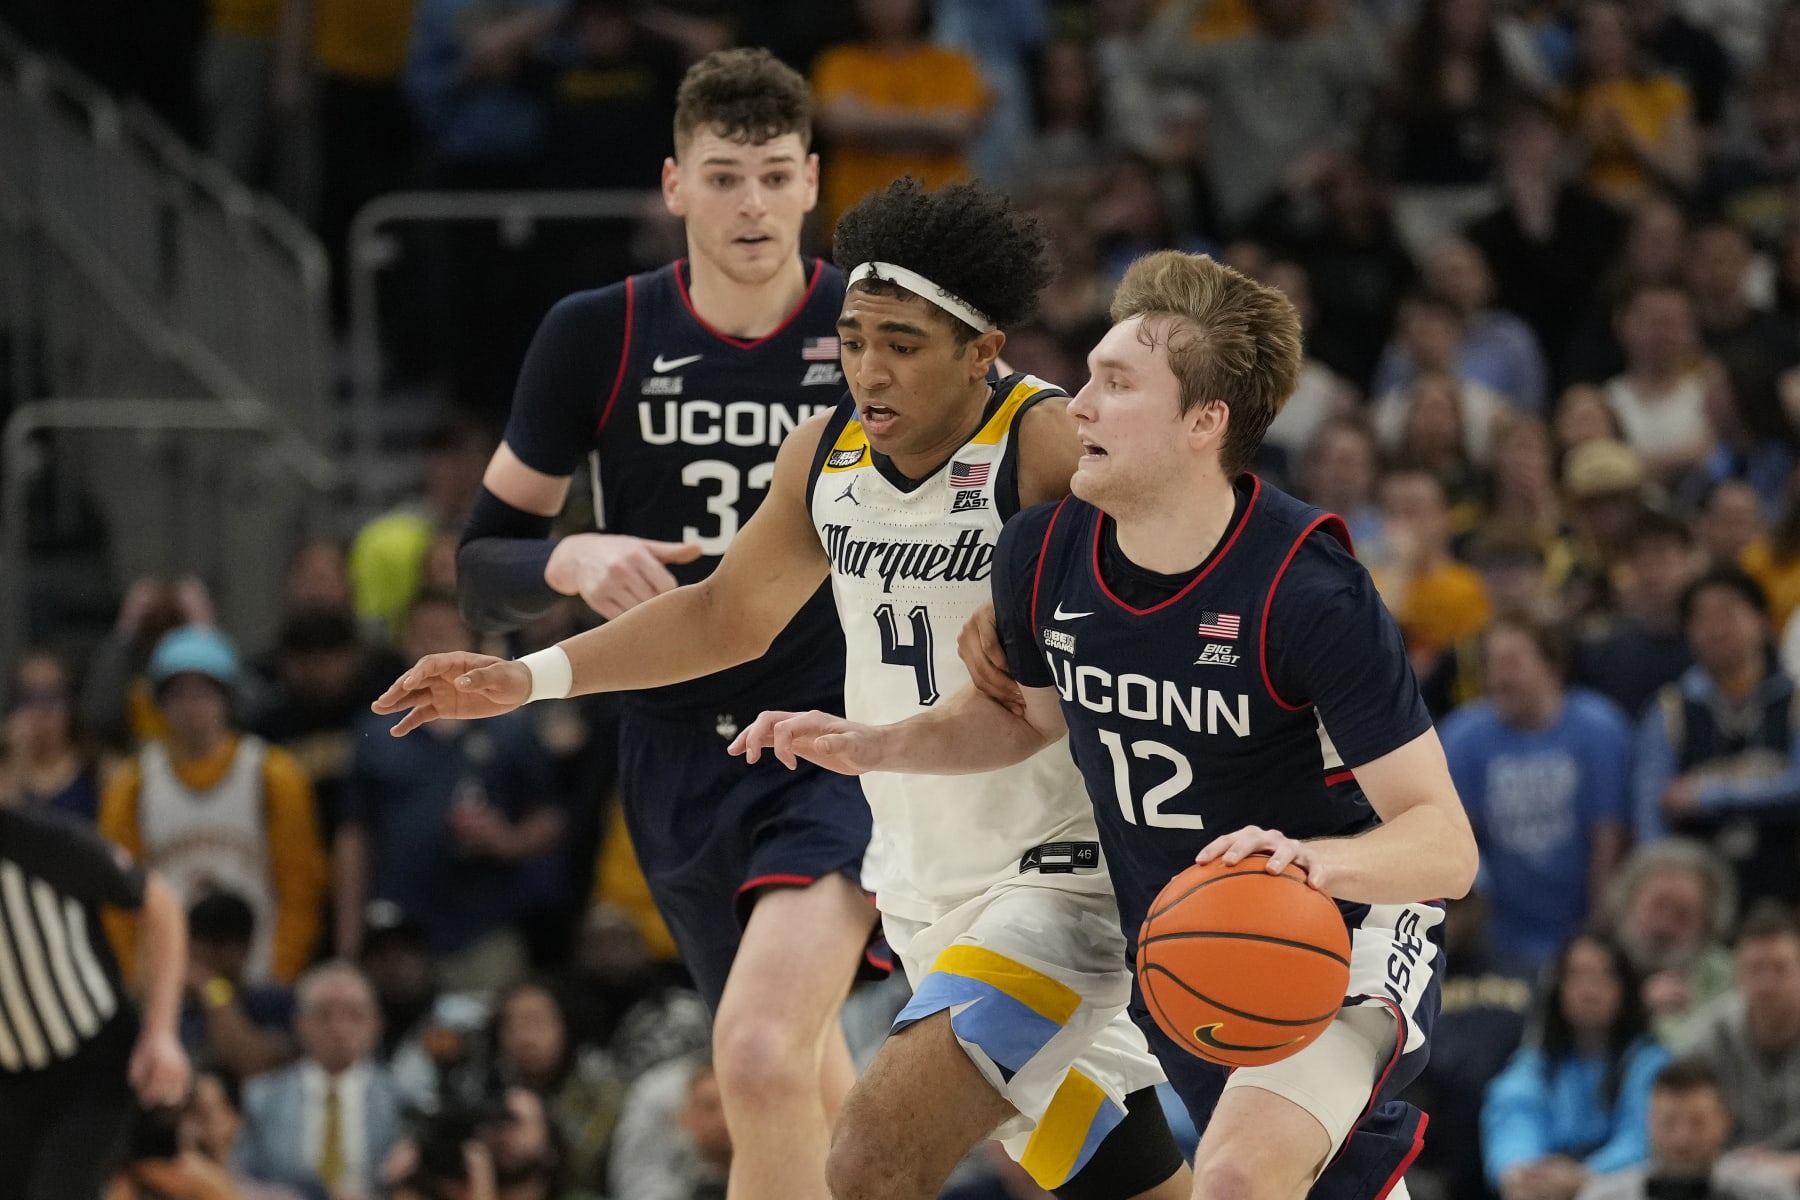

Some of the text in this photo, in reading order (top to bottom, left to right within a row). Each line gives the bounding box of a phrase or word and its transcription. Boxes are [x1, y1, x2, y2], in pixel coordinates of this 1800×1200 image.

[638, 400, 828, 447] UCON
[681, 459, 775, 556] 3
[953, 498, 989, 509] EAST
[955, 489, 982, 500] BIG
[822, 523, 994, 594] Marquette
[873, 603, 940, 706] 4
[1198, 652, 1241, 664] EAST
[1203, 643, 1233, 655] BIG
[1045, 650, 1251, 738] UCONN
[1098, 728, 1205, 830] 12
[1077, 849, 1092, 860] 46
